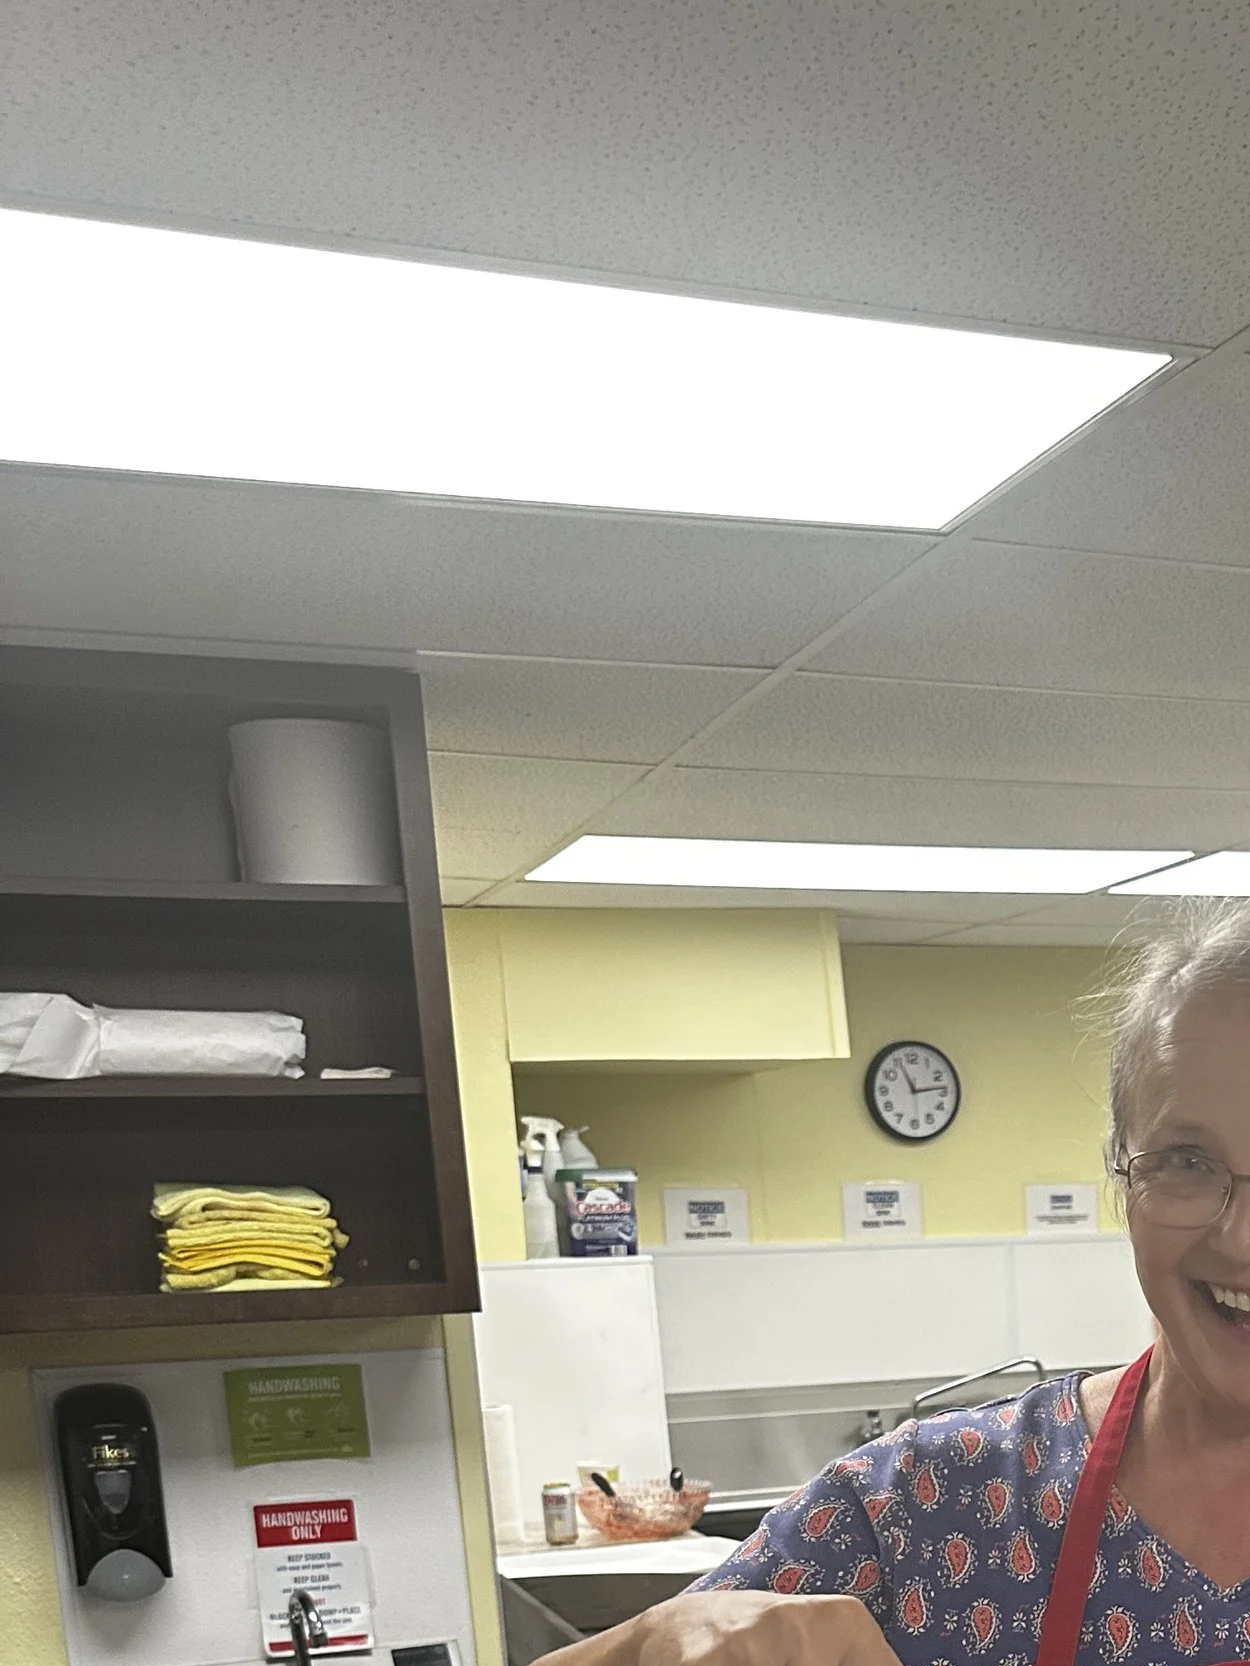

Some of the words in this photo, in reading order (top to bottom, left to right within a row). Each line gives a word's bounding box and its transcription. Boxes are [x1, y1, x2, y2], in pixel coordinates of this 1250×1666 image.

[247, 1376, 341, 1395] HANDWASHING
[262, 1508, 349, 1528] HANDWASHING
[292, 1525, 322, 1541] ONLY
